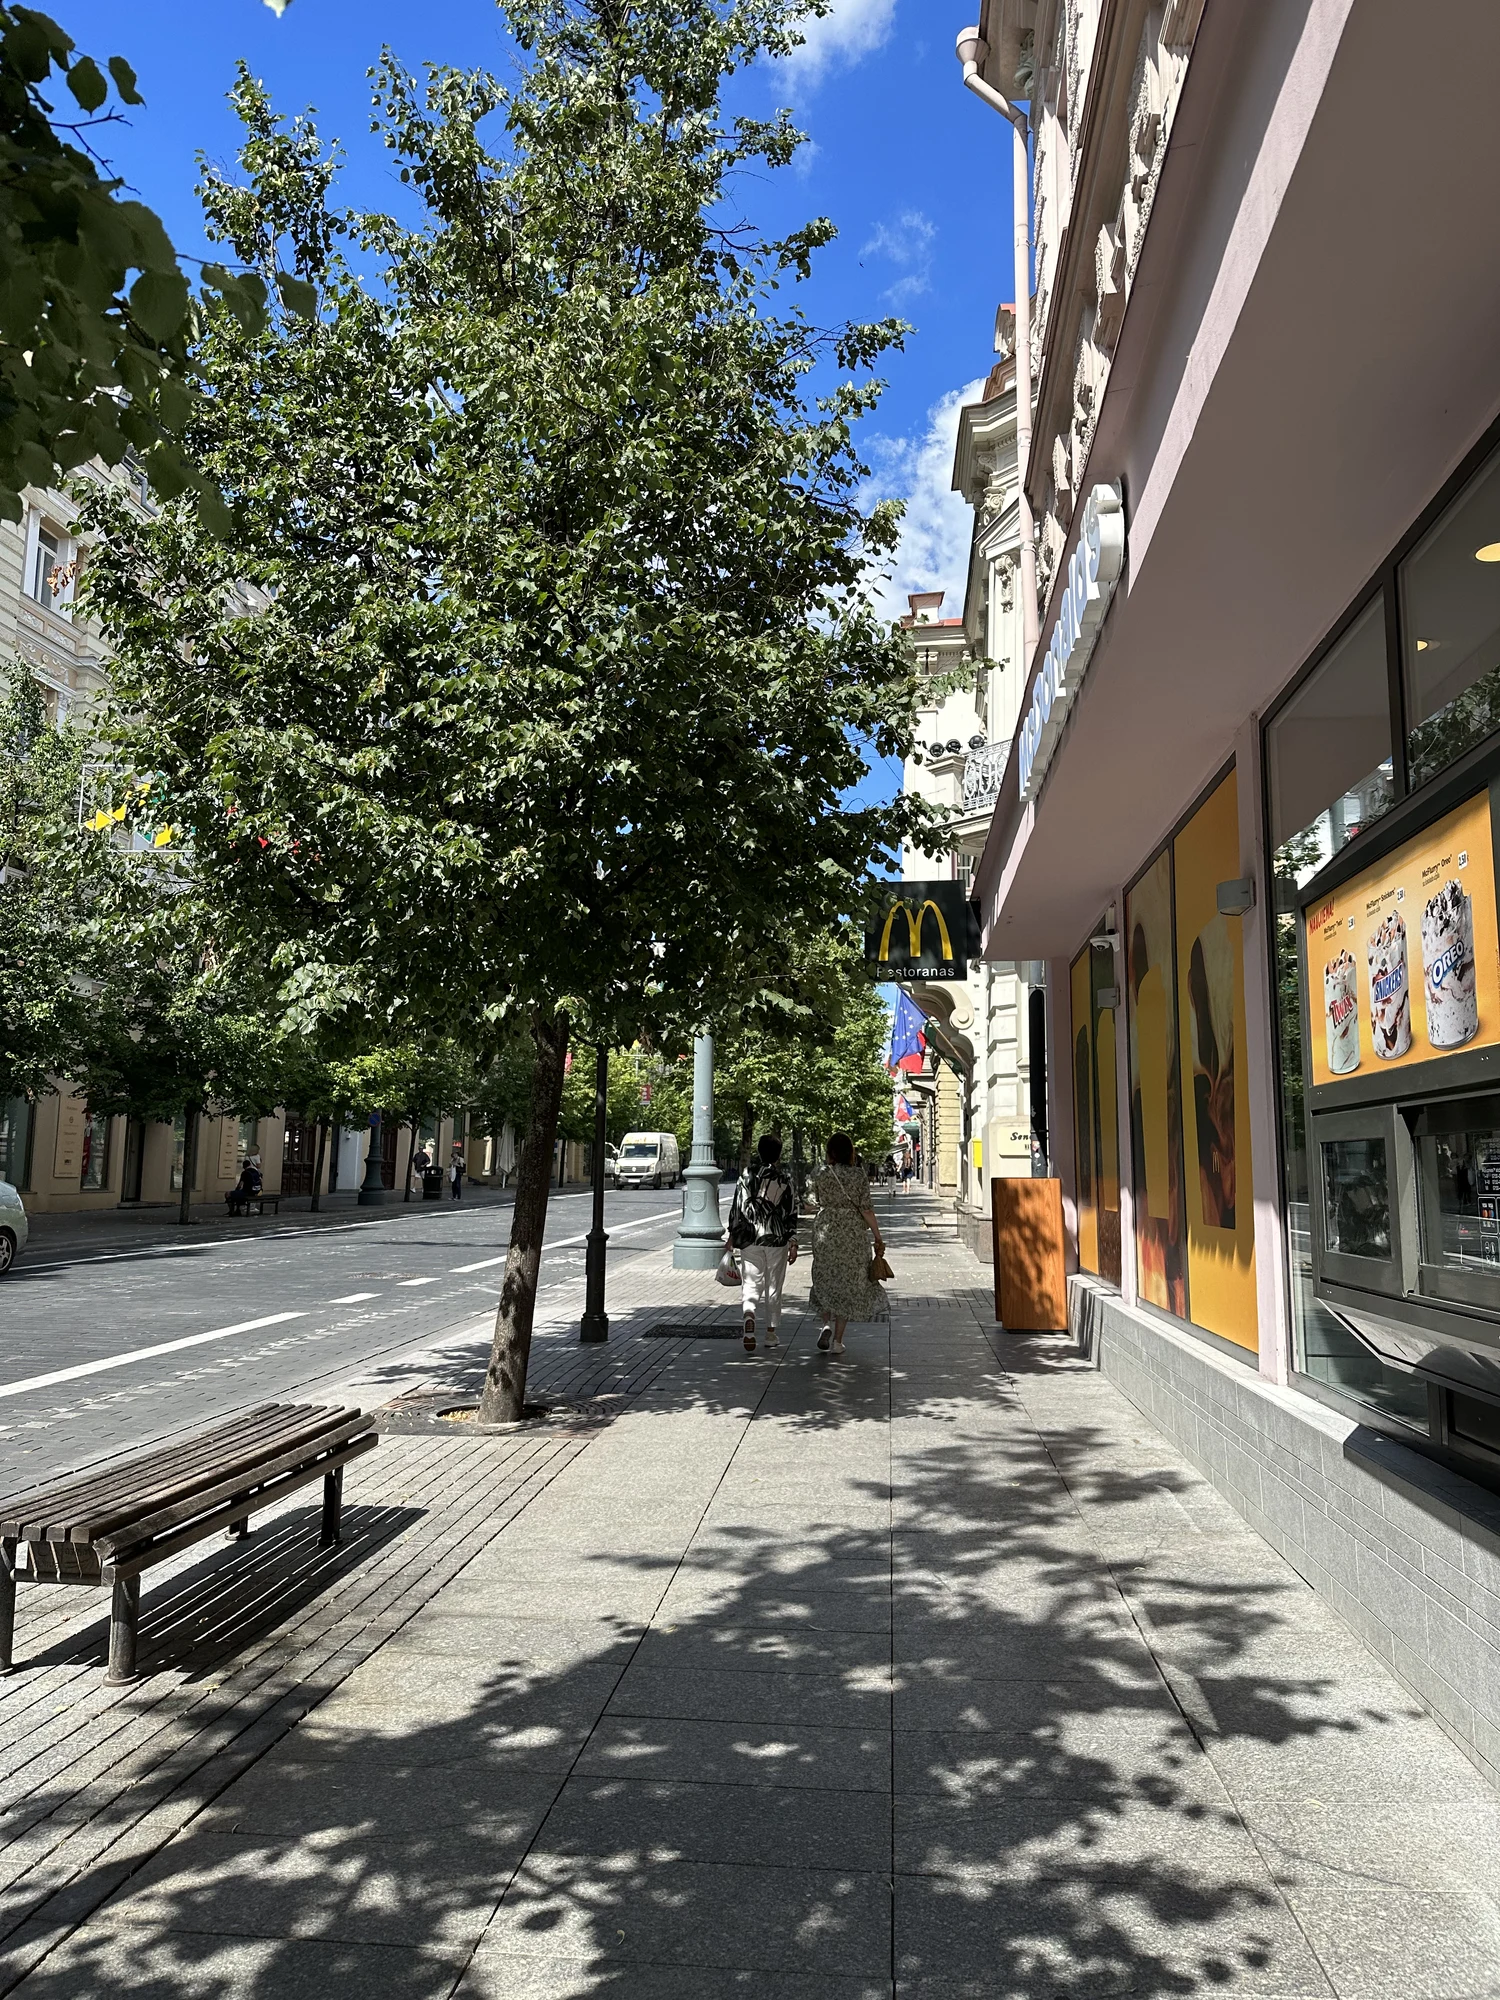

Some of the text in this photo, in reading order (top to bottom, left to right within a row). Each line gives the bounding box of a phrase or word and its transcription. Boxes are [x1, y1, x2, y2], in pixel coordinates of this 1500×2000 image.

[1432, 940, 1464, 984] OREO
[1375, 965, 1403, 1002] SNICKERS
[1010, 1131, 1031, 1142] Sen
